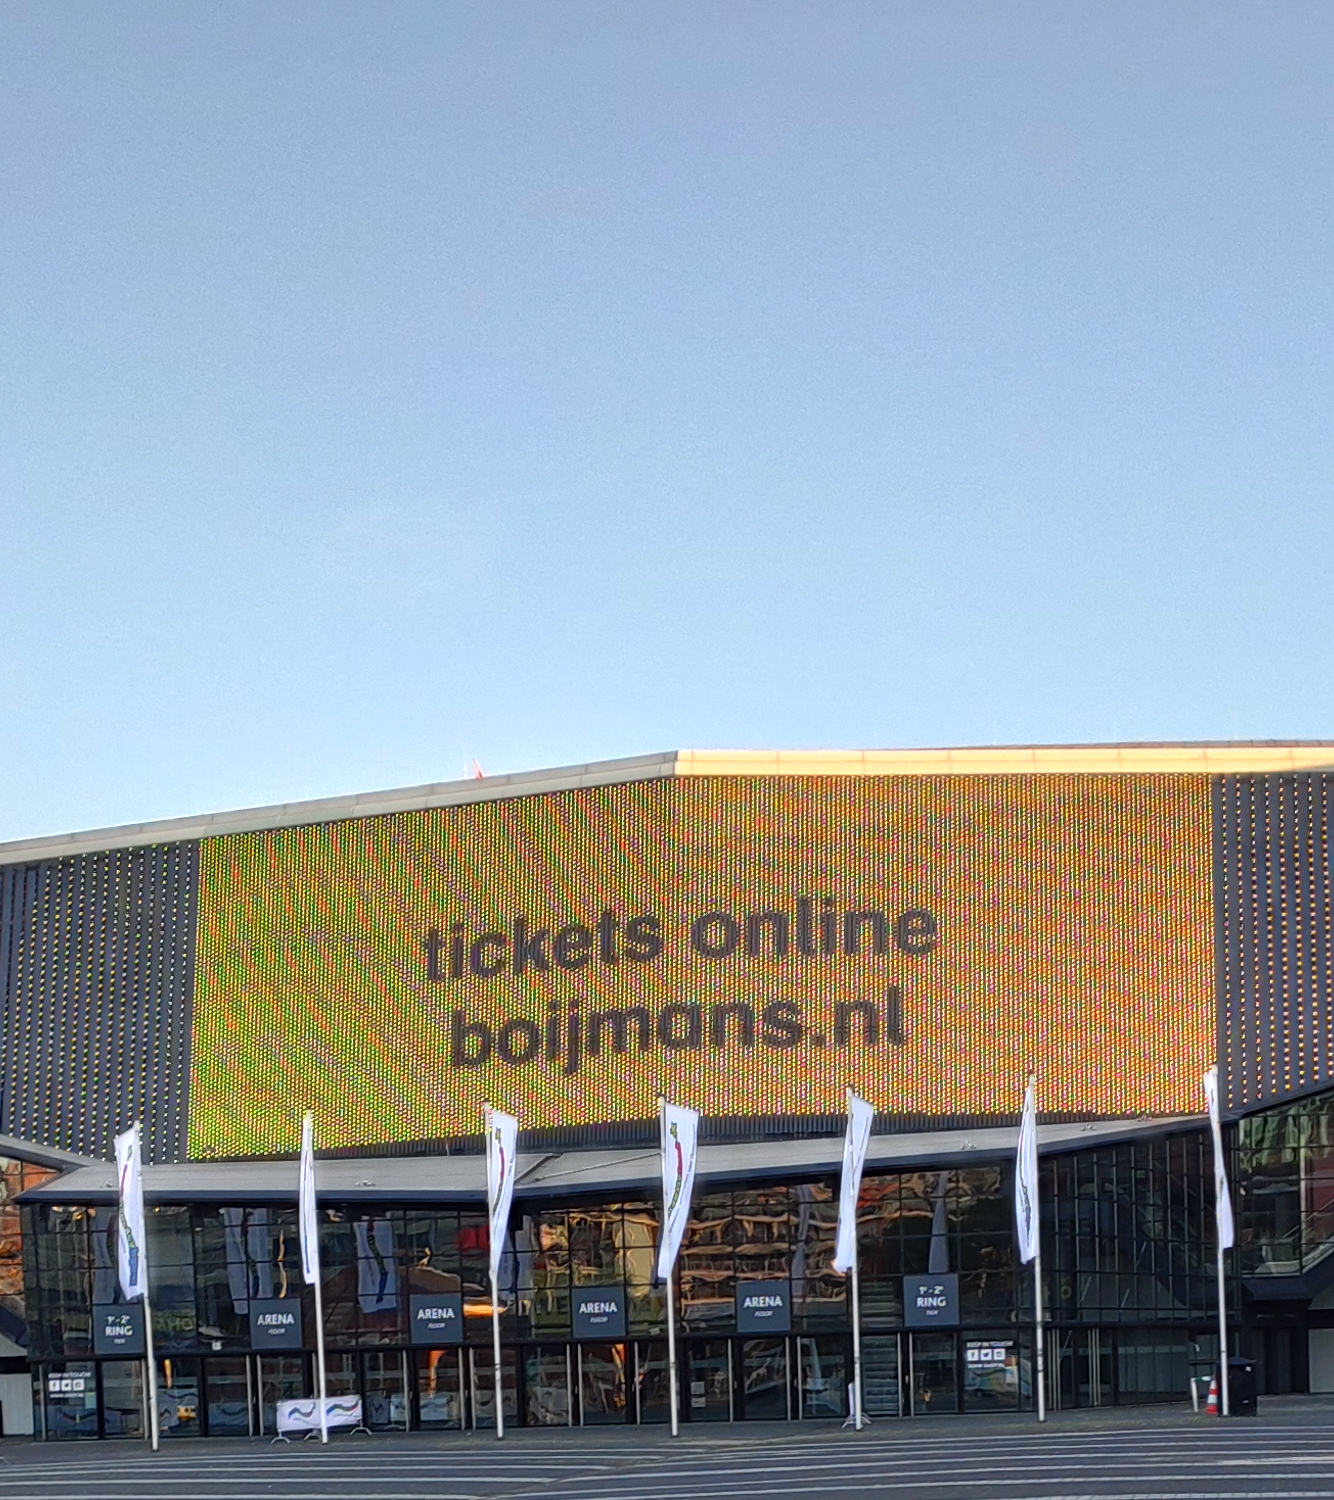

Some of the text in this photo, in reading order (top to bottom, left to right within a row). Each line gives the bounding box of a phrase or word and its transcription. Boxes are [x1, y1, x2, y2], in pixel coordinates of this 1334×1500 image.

[425, 894, 936, 981] tickets online
[450, 985, 907, 1074] boijmans.nl
[578, 1301, 618, 1314] ARENA
[743, 1294, 784, 1308] ARENA
[917, 1296, 947, 1307] RING
[256, 1313, 295, 1326] ARENA
[416, 1307, 455, 1320] ARENA
[105, 1325, 133, 1337] RING
